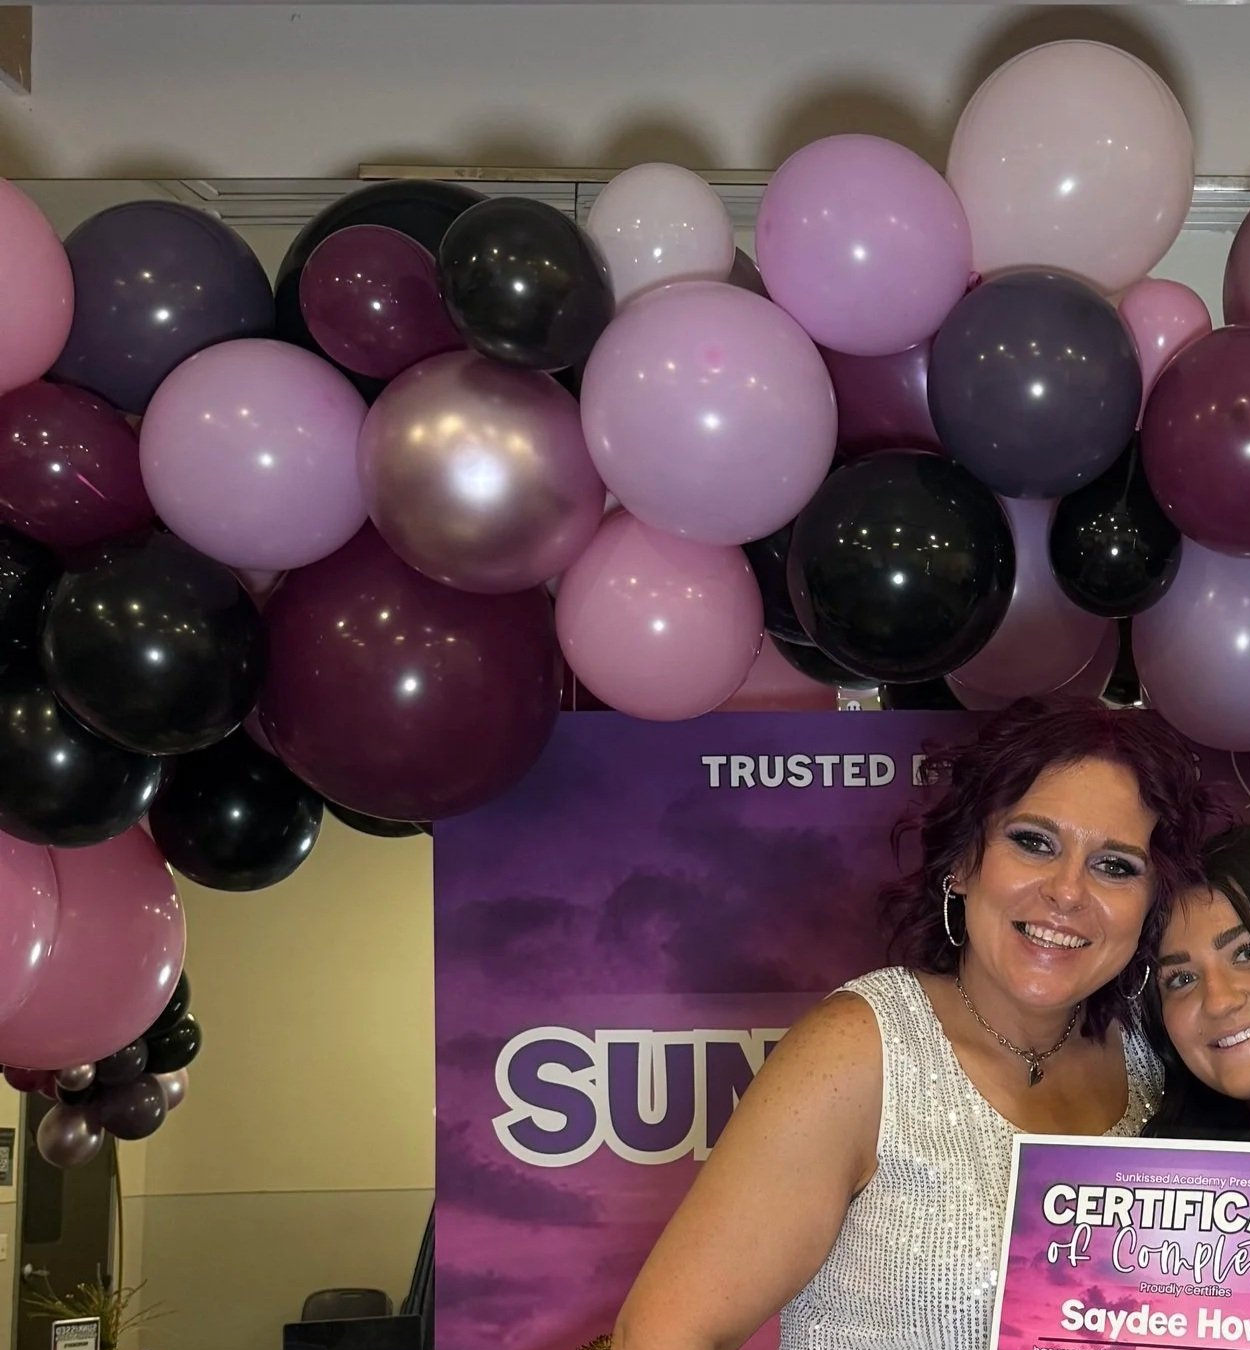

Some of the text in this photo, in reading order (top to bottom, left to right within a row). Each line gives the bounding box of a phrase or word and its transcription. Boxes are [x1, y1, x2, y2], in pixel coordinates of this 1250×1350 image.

[701, 754, 896, 788] TRUSTED
[491, 1026, 791, 1168] SUN
[1115, 1171, 1170, 1185] Sunkissed
[1172, 1174, 1227, 1189] Academy
[1047, 1223, 1093, 1268] of
[1139, 1282, 1233, 1298] Proudly Certifies
[1060, 1298, 1188, 1341] Saydee
